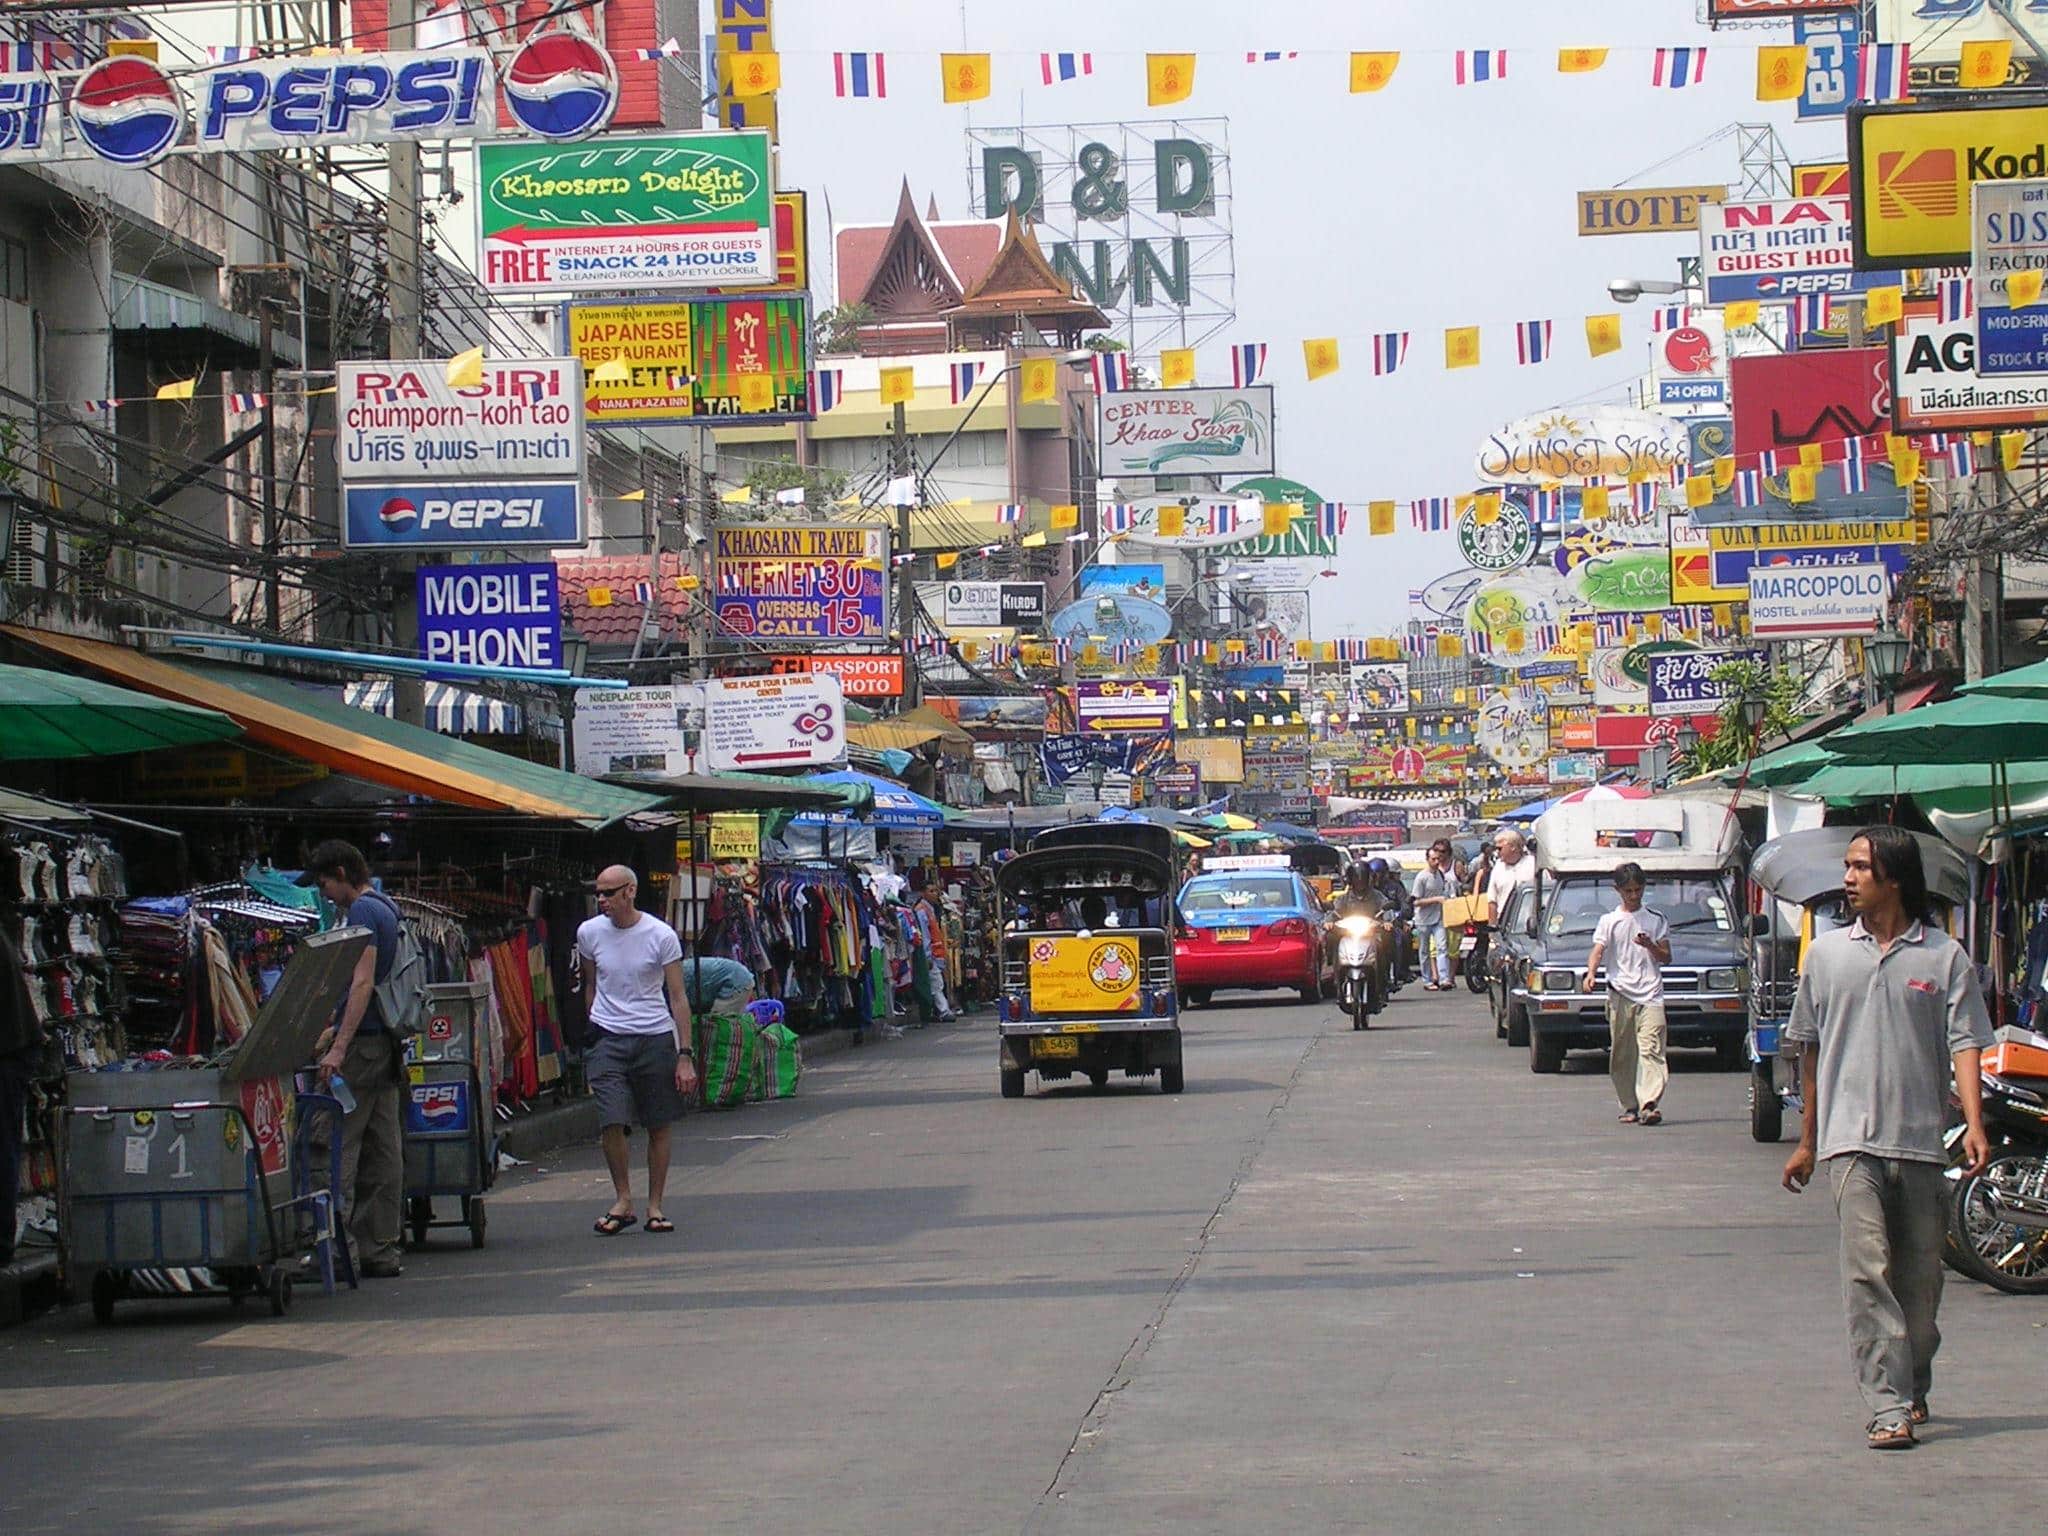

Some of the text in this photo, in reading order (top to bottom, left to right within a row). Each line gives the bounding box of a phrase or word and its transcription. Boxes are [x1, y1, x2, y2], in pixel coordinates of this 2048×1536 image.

[203, 57, 485, 139] PEPSI
[501, 166, 744, 199] Khaosarn Delight
[707, 187, 745, 205] Inn
[555, 239, 762, 256] INTERNET 24 HOURS FOR GUESTS
[487, 248, 552, 284] FREE
[558, 252, 757, 271] SNACK 24 HOURS
[1717, 251, 1799, 272] GUEST
[559, 266, 759, 281] CLEANING ROOM & SAFETY LOCKER
[1780, 273, 1852, 294] PEPSI
[578, 321, 688, 343] JAPANESE
[580, 344, 689, 361] RESTAURANT
[1988, 352, 2032, 367] STOCK
[1664, 384, 1718, 398] 24 OPEN
[531, 401, 570, 425] tao
[600, 397, 688, 409] NANA PLAZA INN
[1104, 400, 1198, 423] CENTER
[1104, 418, 1246, 446] Khao Sarn
[419, 499, 544, 530] PEPSI
[717, 528, 864, 558] KHAOSARN TRAVEL
[1469, 548, 1520, 569] COFFEE
[819, 559, 863, 598] 30
[1752, 573, 1882, 600] MARCOPOLO
[424, 573, 551, 616] MOBILE
[756, 601, 820, 619] OVERSEAS
[821, 599, 864, 637] 15
[1753, 606, 1799, 618] HOSTEL
[756, 620, 820, 636] CALL
[426, 626, 553, 667] PHONE
[811, 660, 901, 676] PASSPORT
[756, 687, 783, 697] CENTER
[763, 678, 780, 688] TOUR
[1661, 682, 1694, 700] Yui
[645, 690, 672, 701] TOUR
[167, 1133, 194, 1179] 1
